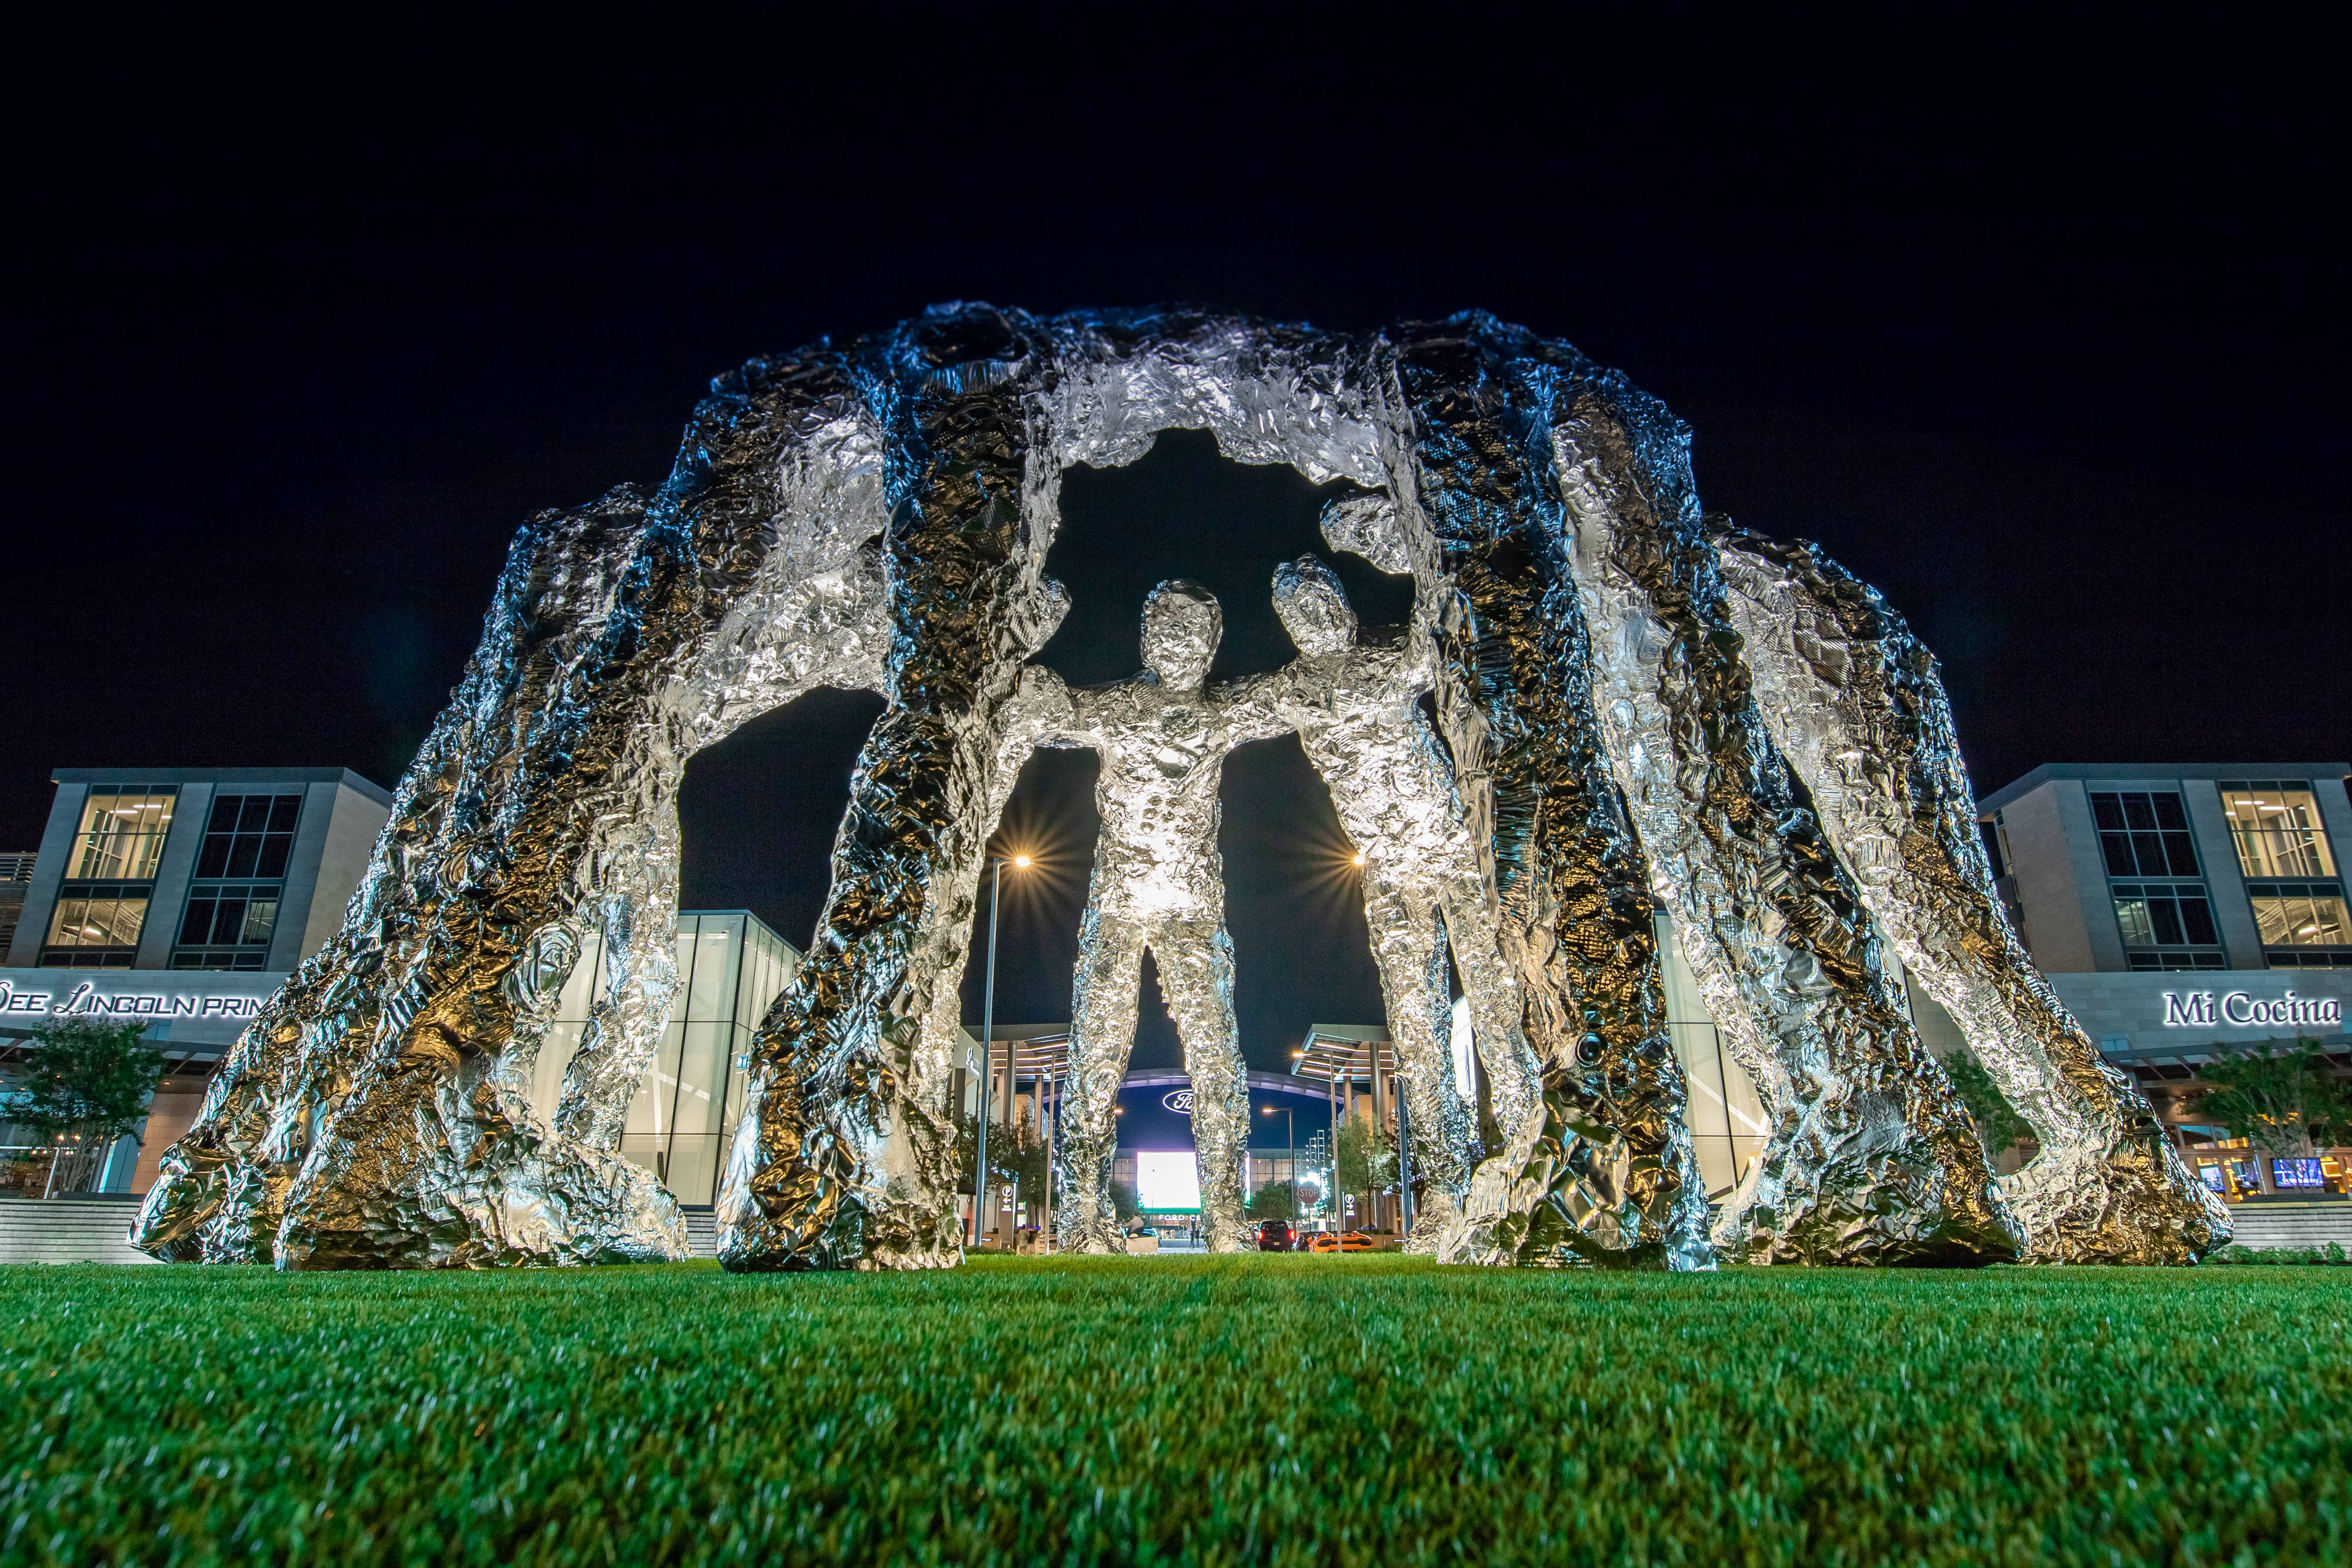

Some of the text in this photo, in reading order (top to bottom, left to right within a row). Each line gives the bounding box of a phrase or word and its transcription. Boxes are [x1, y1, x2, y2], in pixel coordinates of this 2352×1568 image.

[53, 984, 196, 1015] LINCOLN
[2166, 991, 2342, 1024] Mi Cocina
[1299, 1188, 1318, 1197] STOP
